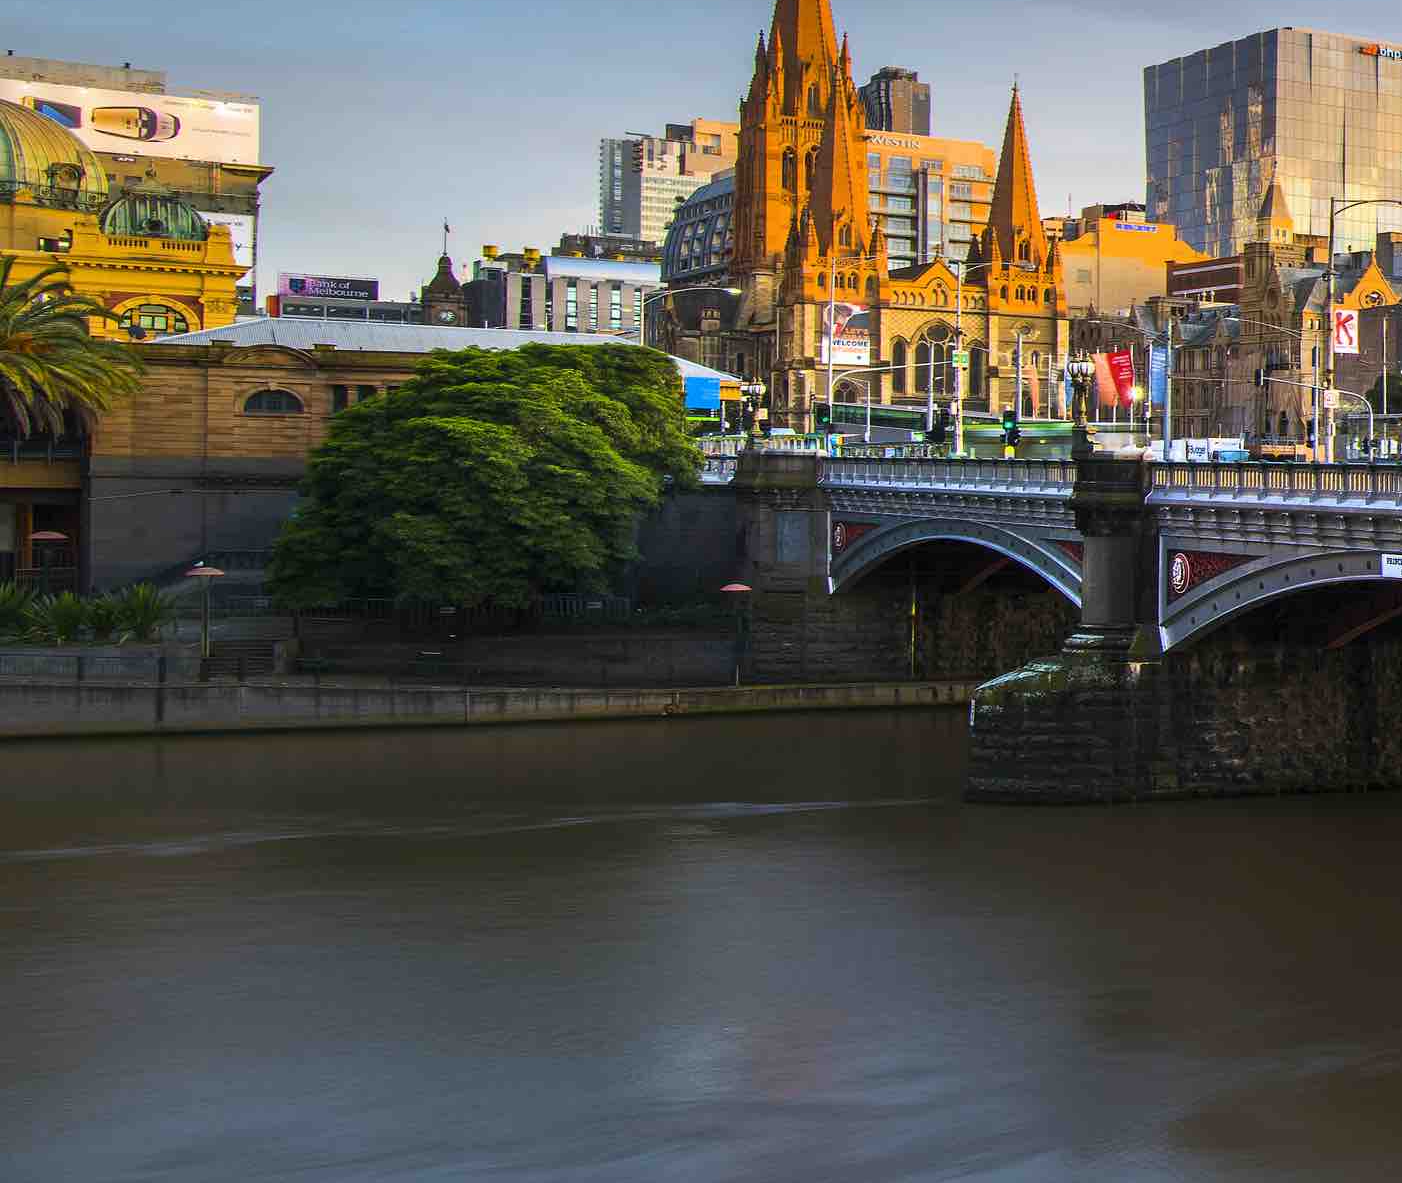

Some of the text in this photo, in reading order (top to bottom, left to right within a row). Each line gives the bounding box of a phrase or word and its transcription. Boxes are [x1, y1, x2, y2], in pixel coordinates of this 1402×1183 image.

[308, 279, 351, 290] Bank of
[308, 286, 369, 299] Melbourne
[832, 339, 869, 348] WELCOME
